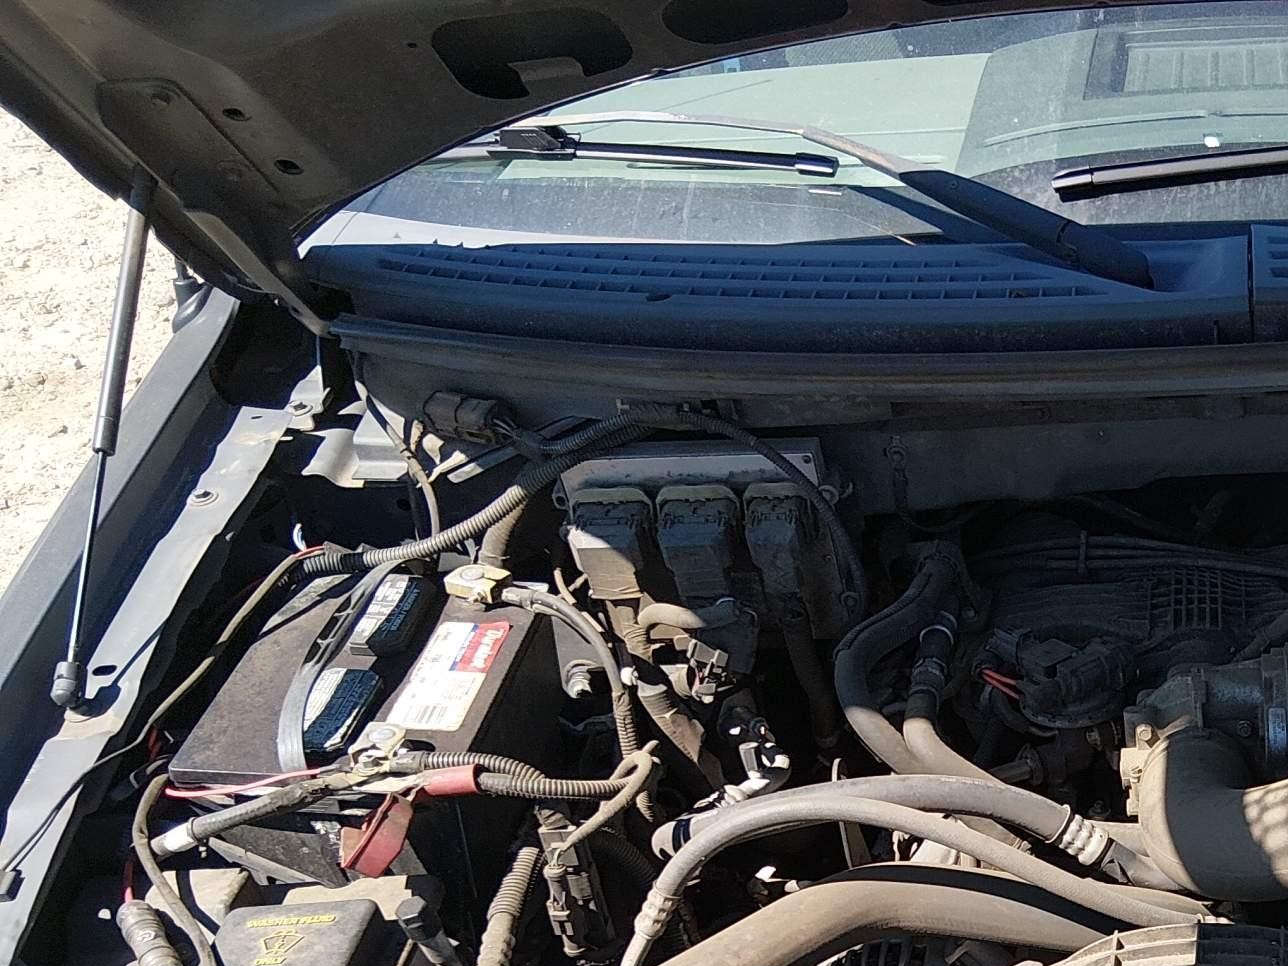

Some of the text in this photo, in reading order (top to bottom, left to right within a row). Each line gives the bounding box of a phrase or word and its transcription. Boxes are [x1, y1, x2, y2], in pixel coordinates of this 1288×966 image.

[247, 914, 337, 928] WASHER FLUID
[254, 957, 288, 966] ONLY
